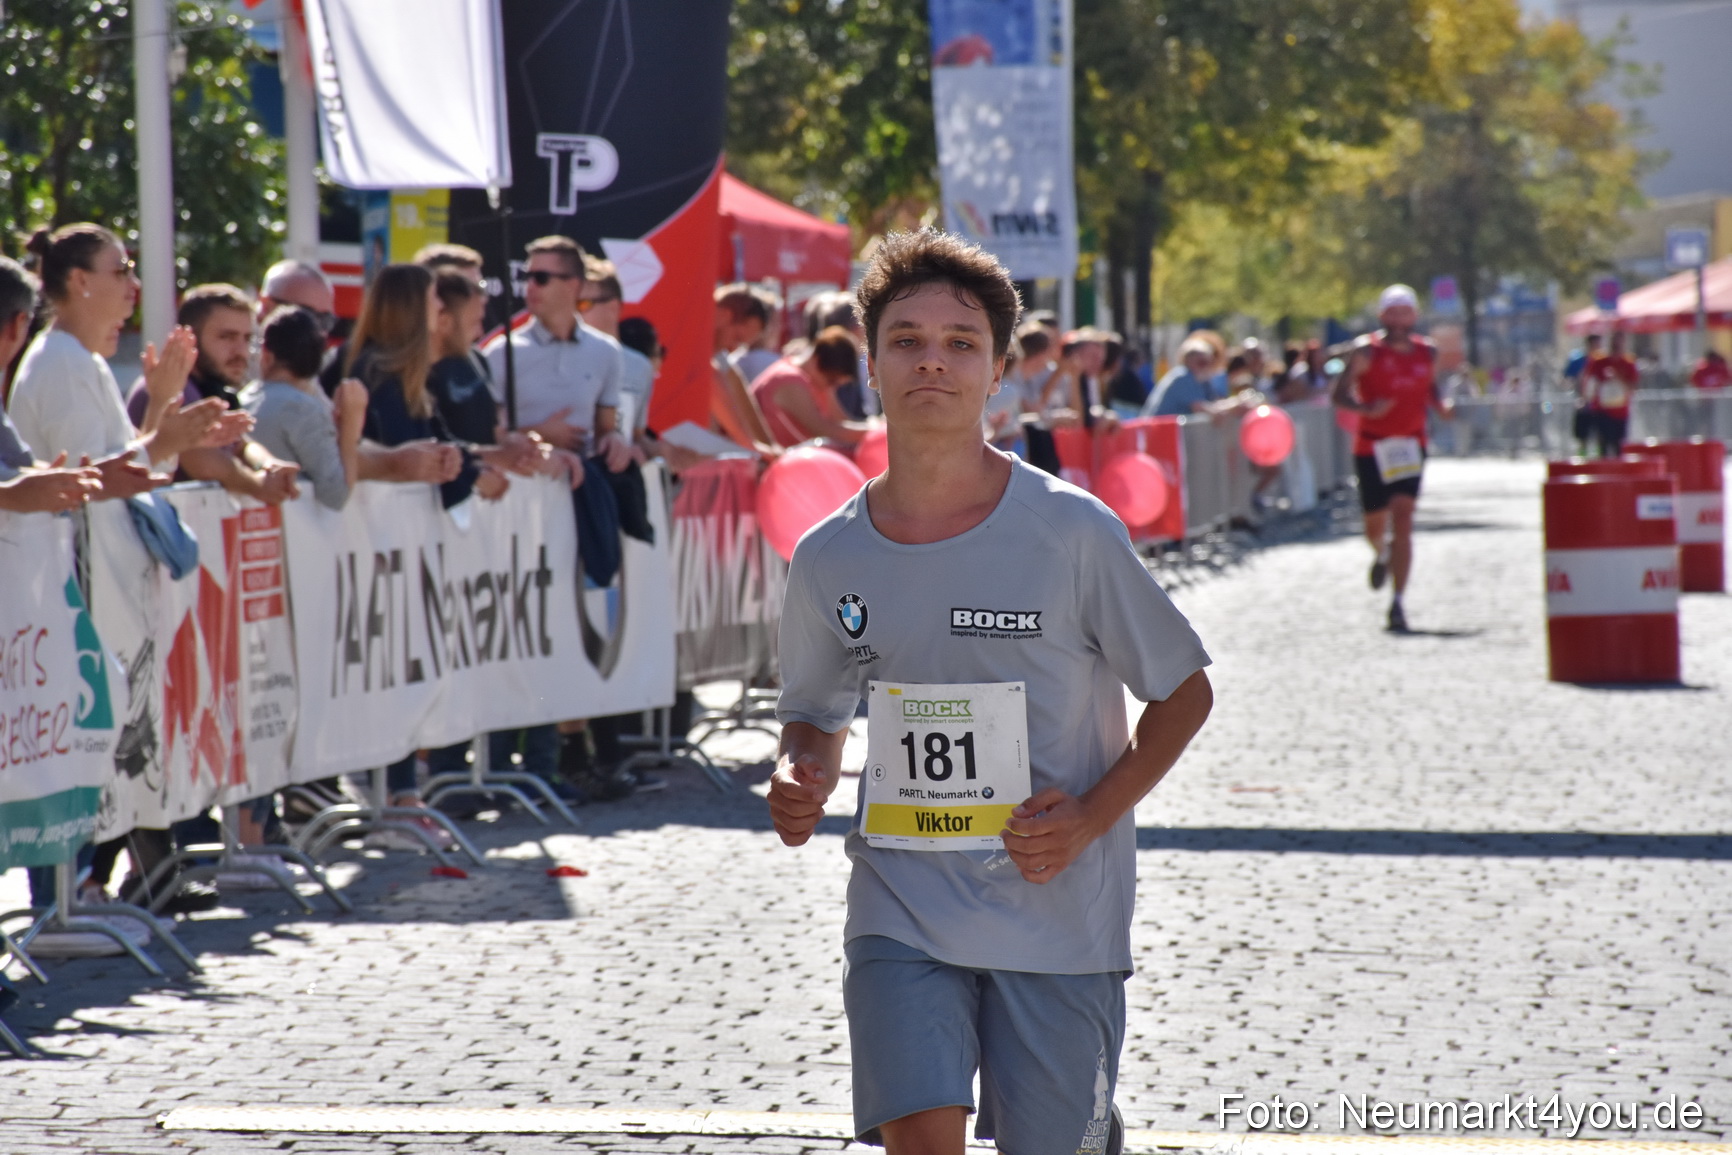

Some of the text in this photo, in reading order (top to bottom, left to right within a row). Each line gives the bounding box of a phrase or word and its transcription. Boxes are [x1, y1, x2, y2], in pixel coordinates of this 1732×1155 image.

[951, 608, 1042, 631] BOCK
[951, 629, 977, 638] inspired
[979, 631, 988, 639] by
[1013, 632, 1042, 640] concepts
[903, 699, 973, 717] BOCK
[901, 731, 976, 781] 181
[899, 788, 978, 800] PARTL Neumarkt
[915, 811, 973, 833] Viktor
[1085, 1120, 1108, 1136] SURF
[1081, 1135, 1105, 1149] COAST
